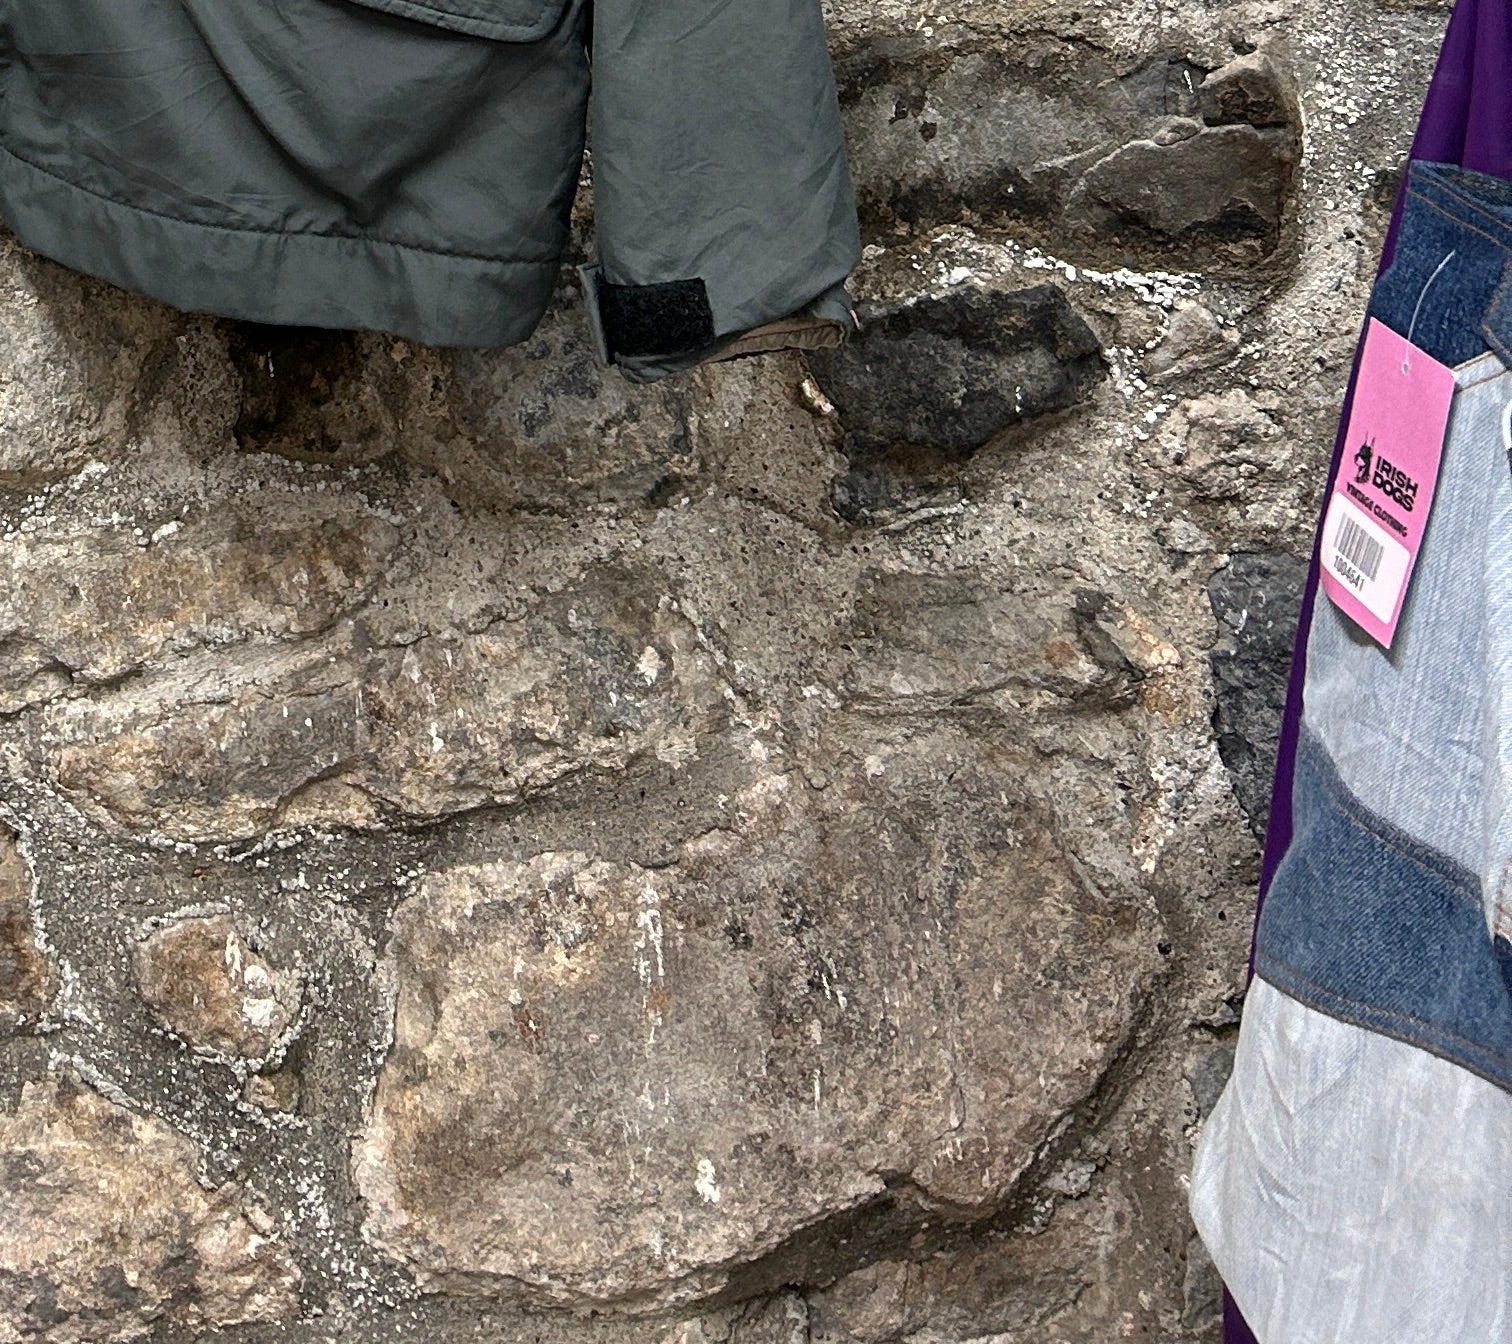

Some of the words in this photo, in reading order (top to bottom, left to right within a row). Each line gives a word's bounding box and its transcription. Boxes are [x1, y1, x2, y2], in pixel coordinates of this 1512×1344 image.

[1372, 470, 1414, 512] DOGS
[1376, 455, 1418, 498] IRISH
[1373, 504, 1408, 538] CLOTHING
